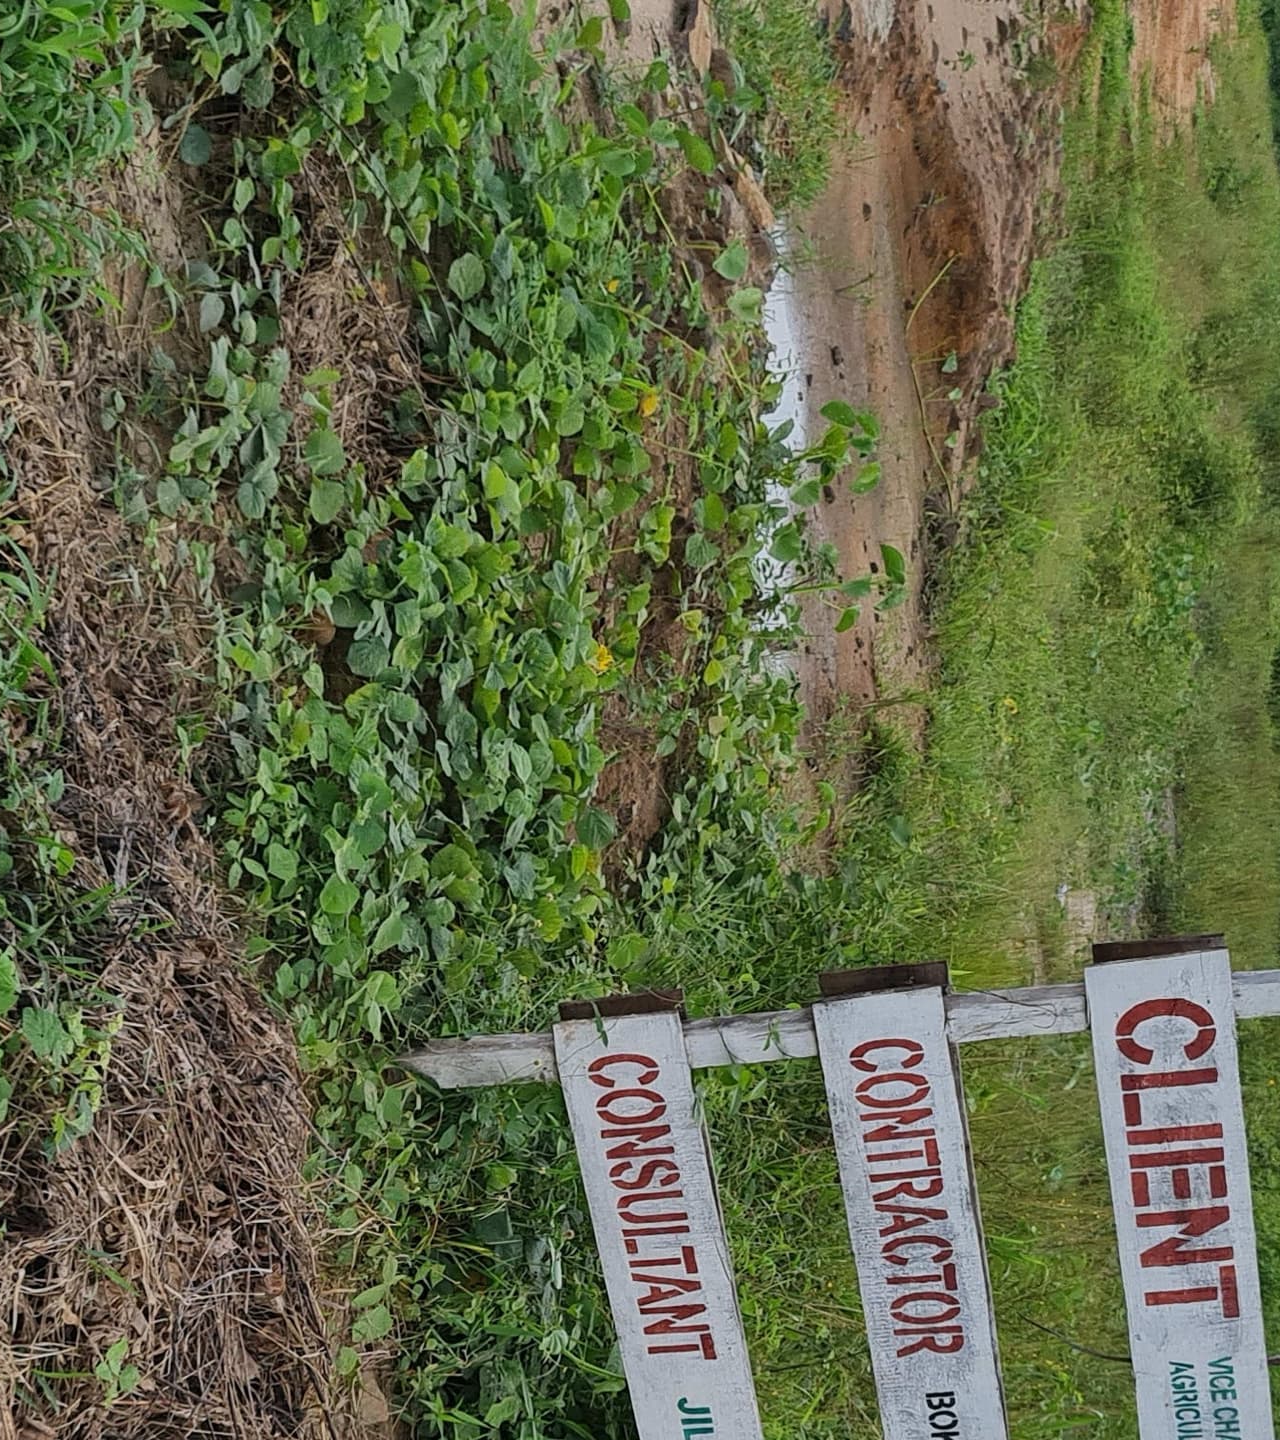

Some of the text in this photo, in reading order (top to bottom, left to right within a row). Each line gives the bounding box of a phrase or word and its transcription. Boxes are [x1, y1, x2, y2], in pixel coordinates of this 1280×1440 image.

[587, 1053, 718, 1361] CONSULTANT
[849, 1038, 965, 1358] CONTRACTOR
[1115, 997, 1241, 1318] CLIENT
[1208, 1356, 1237, 1402] VICE
